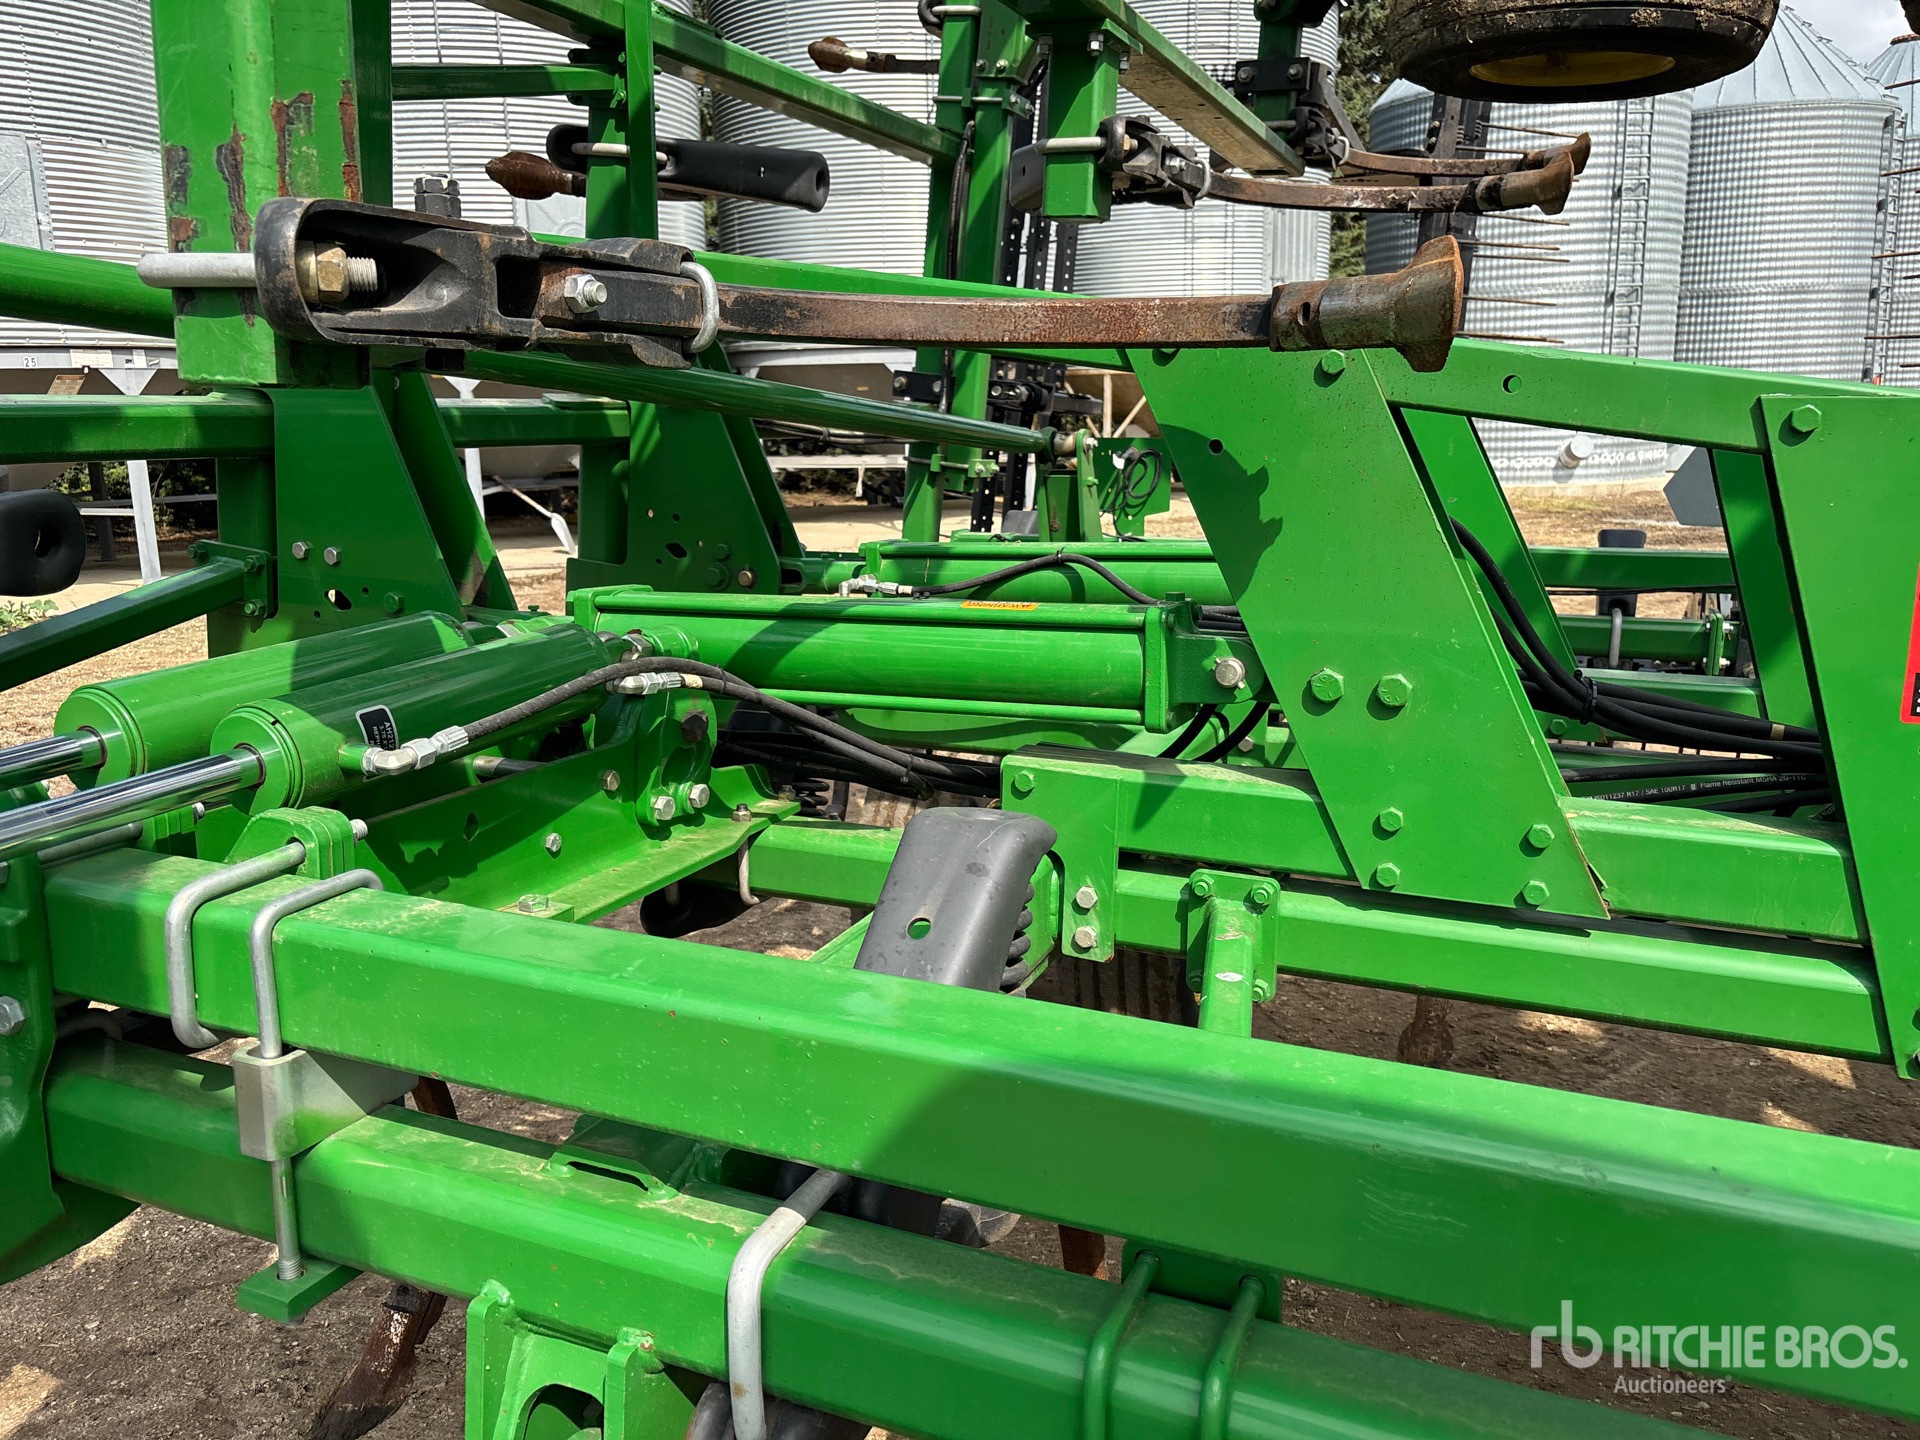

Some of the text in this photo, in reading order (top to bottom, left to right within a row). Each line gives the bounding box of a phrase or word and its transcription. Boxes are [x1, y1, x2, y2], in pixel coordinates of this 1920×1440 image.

[24, 357, 37, 367] 25
[1645, 788, 1659, 796] SAE
[1660, 785, 1686, 794] 100R17
[1722, 778, 1754, 786] Resistant
[1756, 775, 1777, 783] MSHA
